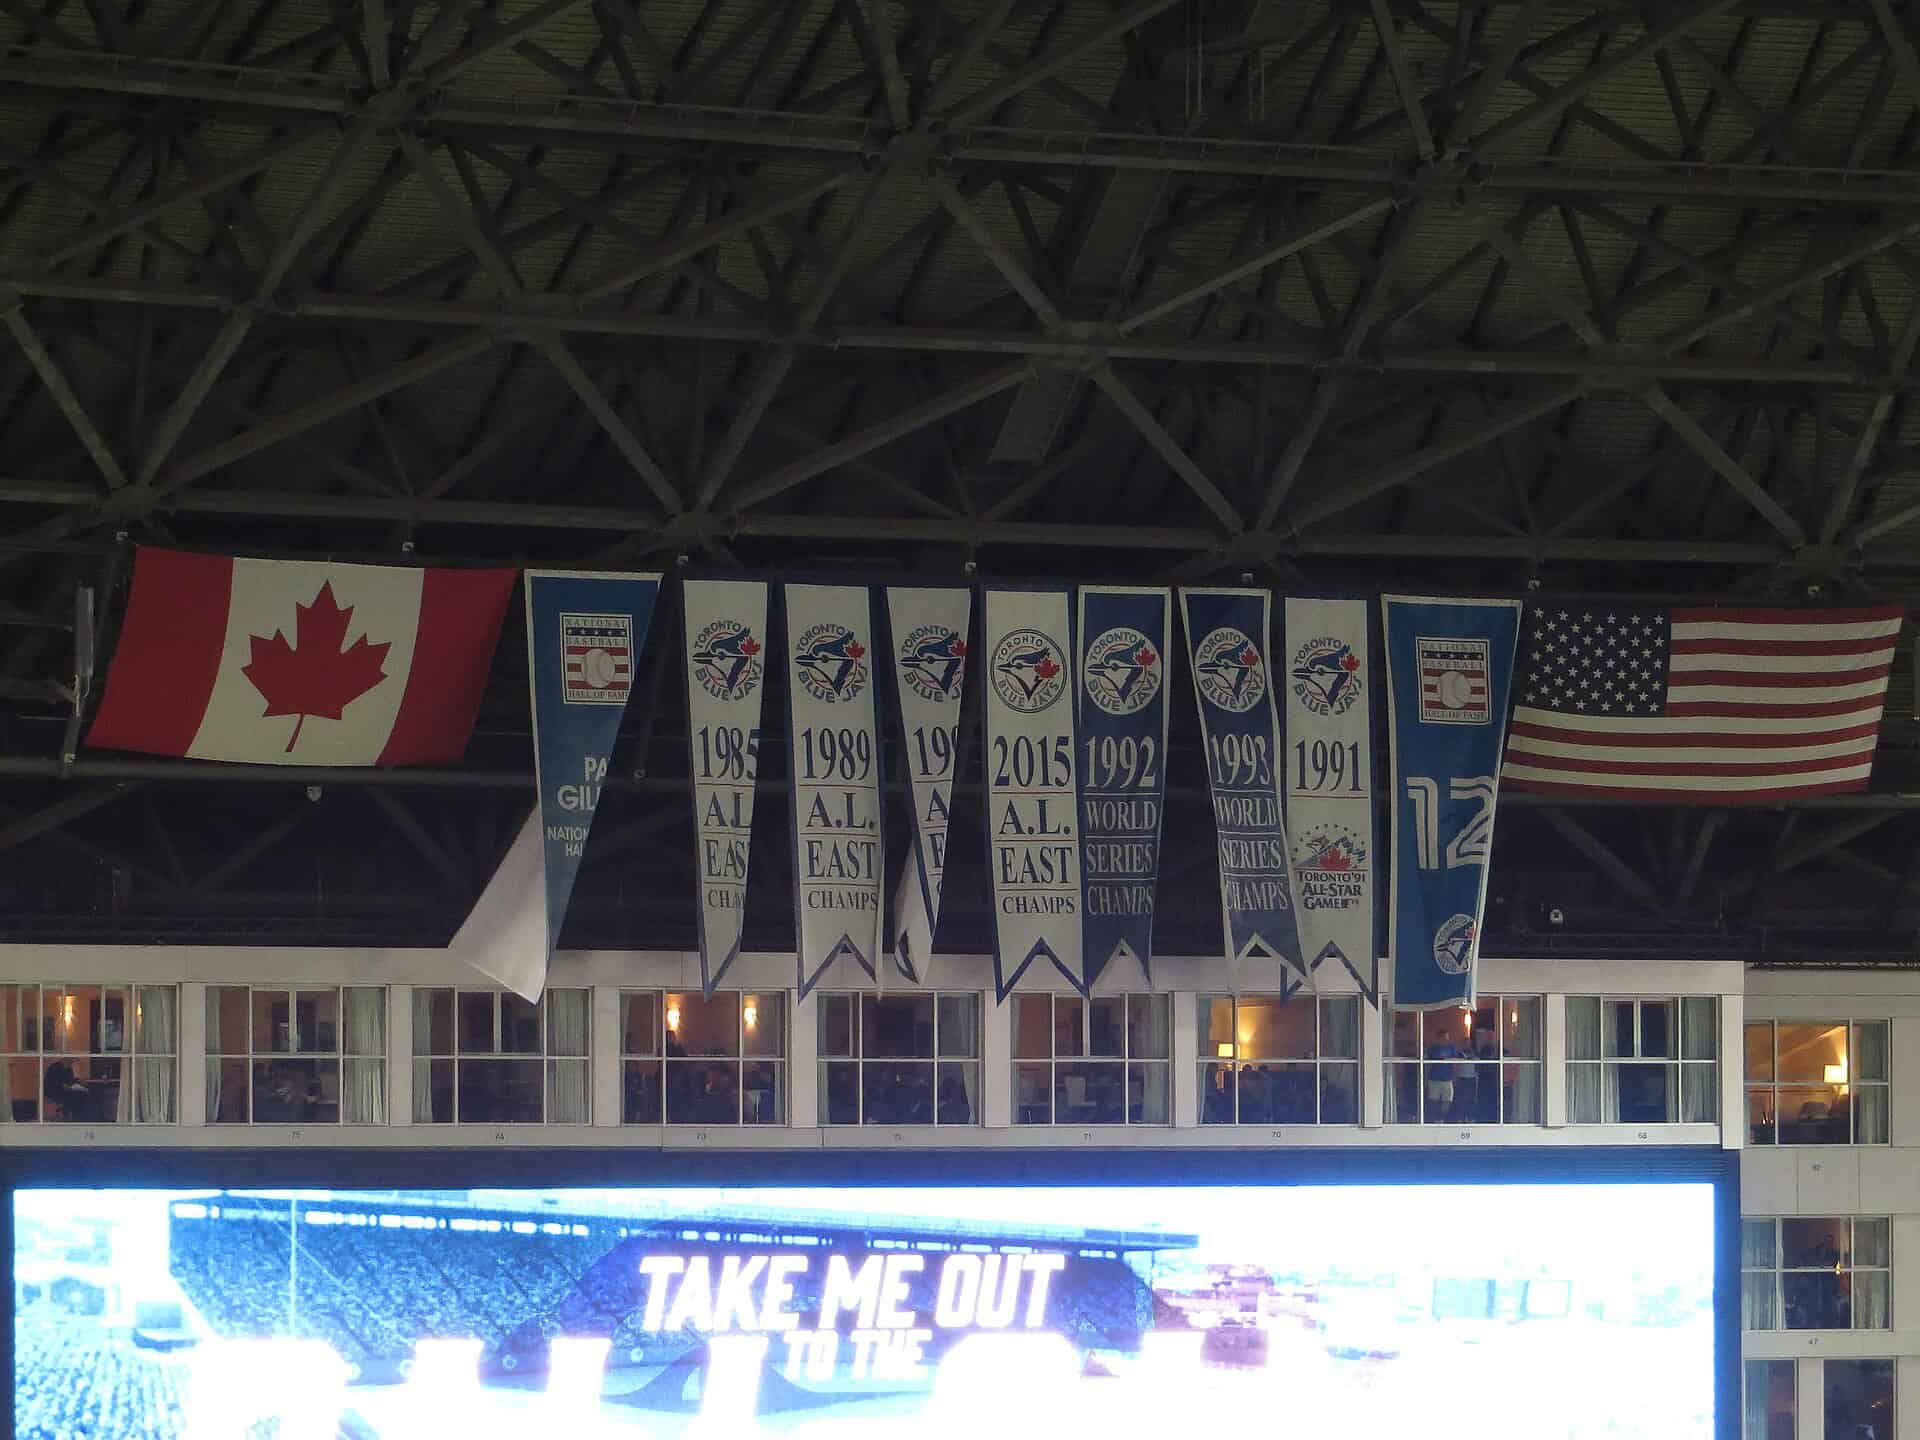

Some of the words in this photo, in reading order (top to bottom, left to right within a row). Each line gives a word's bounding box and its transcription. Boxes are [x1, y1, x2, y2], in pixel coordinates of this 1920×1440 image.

[694, 620, 742, 649] TORONTO
[796, 623, 845, 651] TORONTO
[902, 625, 949, 653] TORONTO
[998, 634, 1043, 661] TORONTO
[1089, 631, 1137, 661] TORONTO
[1201, 632, 1241, 660] TORONTO
[1294, 638, 1342, 664] TORONTO
[694, 668, 730, 703] BLUE
[798, 670, 835, 703] BLUE
[904, 671, 944, 703] BLUE
[1088, 679, 1121, 711] BLUE
[1202, 677, 1237, 709] BLUE
[698, 725, 760, 781] 1985
[801, 727, 872, 781] 1989
[993, 735, 1071, 787] 2015
[1084, 736, 1156, 789] 1992
[1211, 734, 1271, 785] 1993
[1295, 739, 1364, 792] 1991
[806, 791, 875, 829] A.L.
[998, 799, 1071, 835] A.L.
[1085, 800, 1157, 831] WORLD
[1215, 796, 1278, 827] WORLD
[1406, 776, 1495, 870] 12
[705, 839, 751, 879] EAS
[806, 839, 876, 880] EAST
[1000, 847, 1073, 884] EAST
[1085, 843, 1153, 873] SERIES
[1220, 838, 1281, 869] SERIES
[807, 890, 878, 911] CHAMPS
[1002, 895, 1076, 914] CHAMPS
[1087, 886, 1153, 916] CHAMPS
[1225, 880, 1288, 912] CHAMPS
[1302, 882, 1362, 897] ALL-STAR
[639, 1254, 808, 1332] TAKE
[820, 1254, 924, 1330] ME
[934, 1254, 1066, 1328] OUT
[784, 1330, 839, 1380] TO
